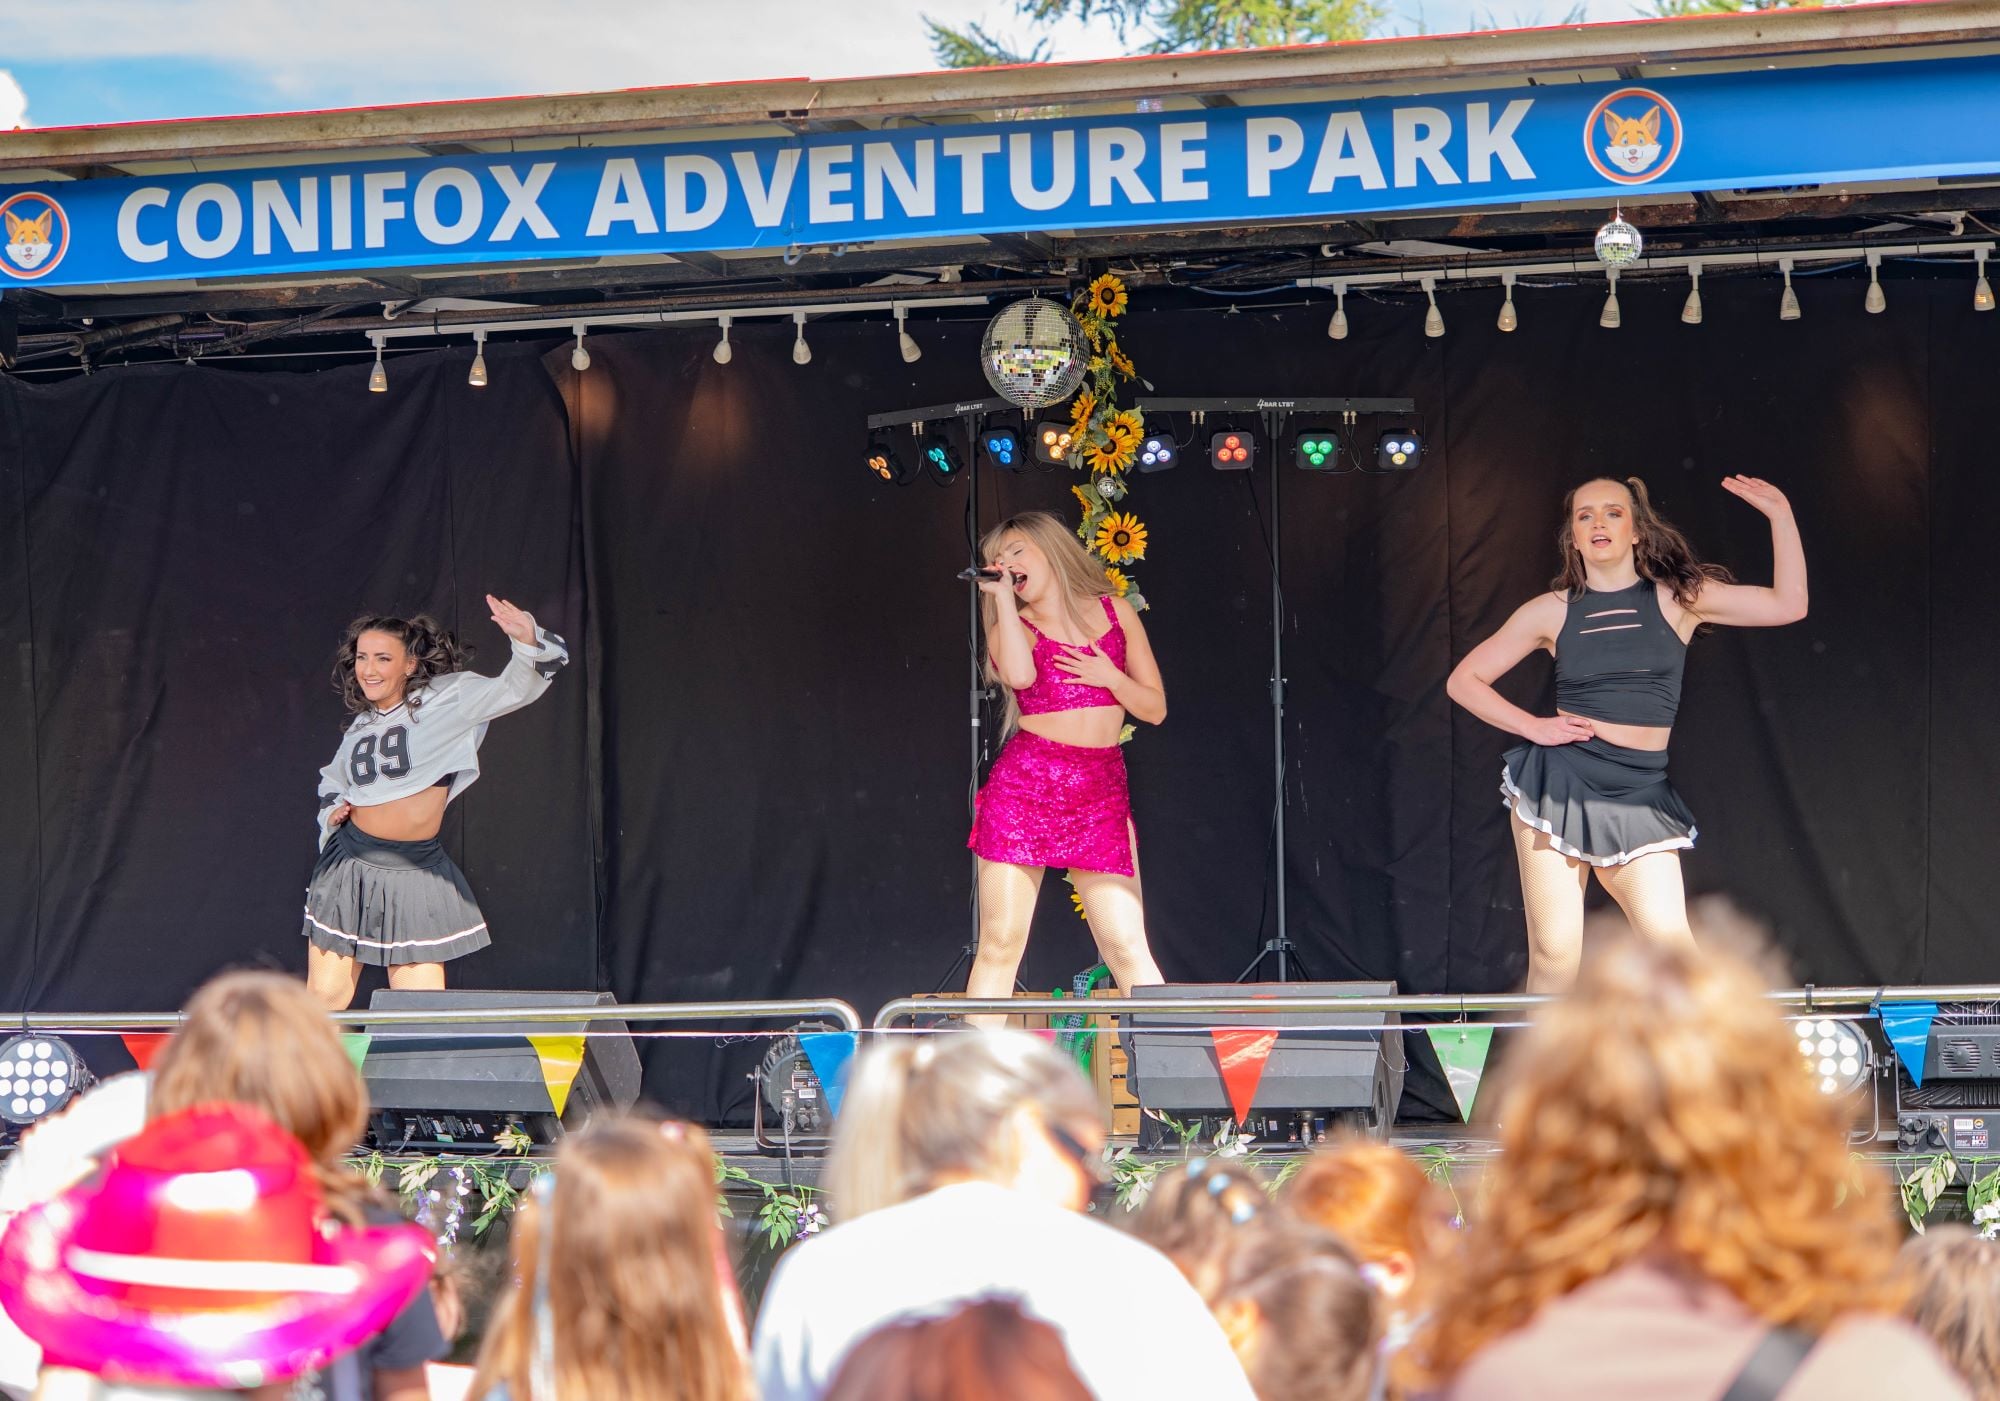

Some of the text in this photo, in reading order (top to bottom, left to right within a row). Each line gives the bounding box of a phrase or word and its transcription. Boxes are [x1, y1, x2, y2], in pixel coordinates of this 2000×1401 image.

[116, 98, 1537, 264] CONIFOX ADVENTURE PARK
[350, 724, 413, 788] 89
